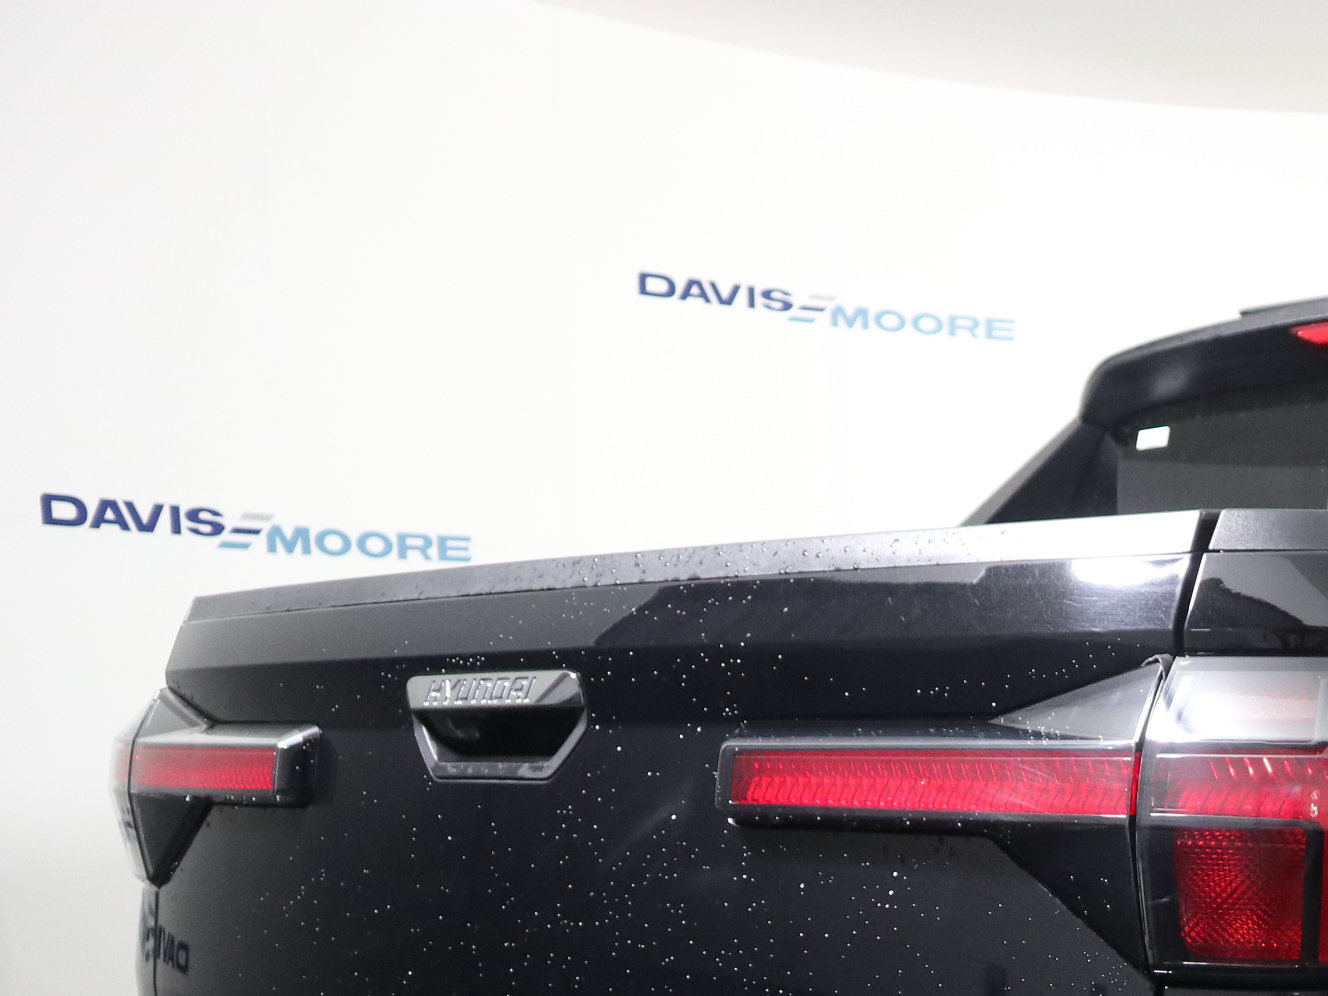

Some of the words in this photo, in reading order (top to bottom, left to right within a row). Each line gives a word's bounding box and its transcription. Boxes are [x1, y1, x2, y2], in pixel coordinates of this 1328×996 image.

[638, 271, 794, 312] DAVIS
[829, 304, 1015, 341] MOORE
[40, 492, 226, 537] DAVIS
[265, 523, 472, 562] MOORE
[423, 676, 537, 706] HYUNDAI
